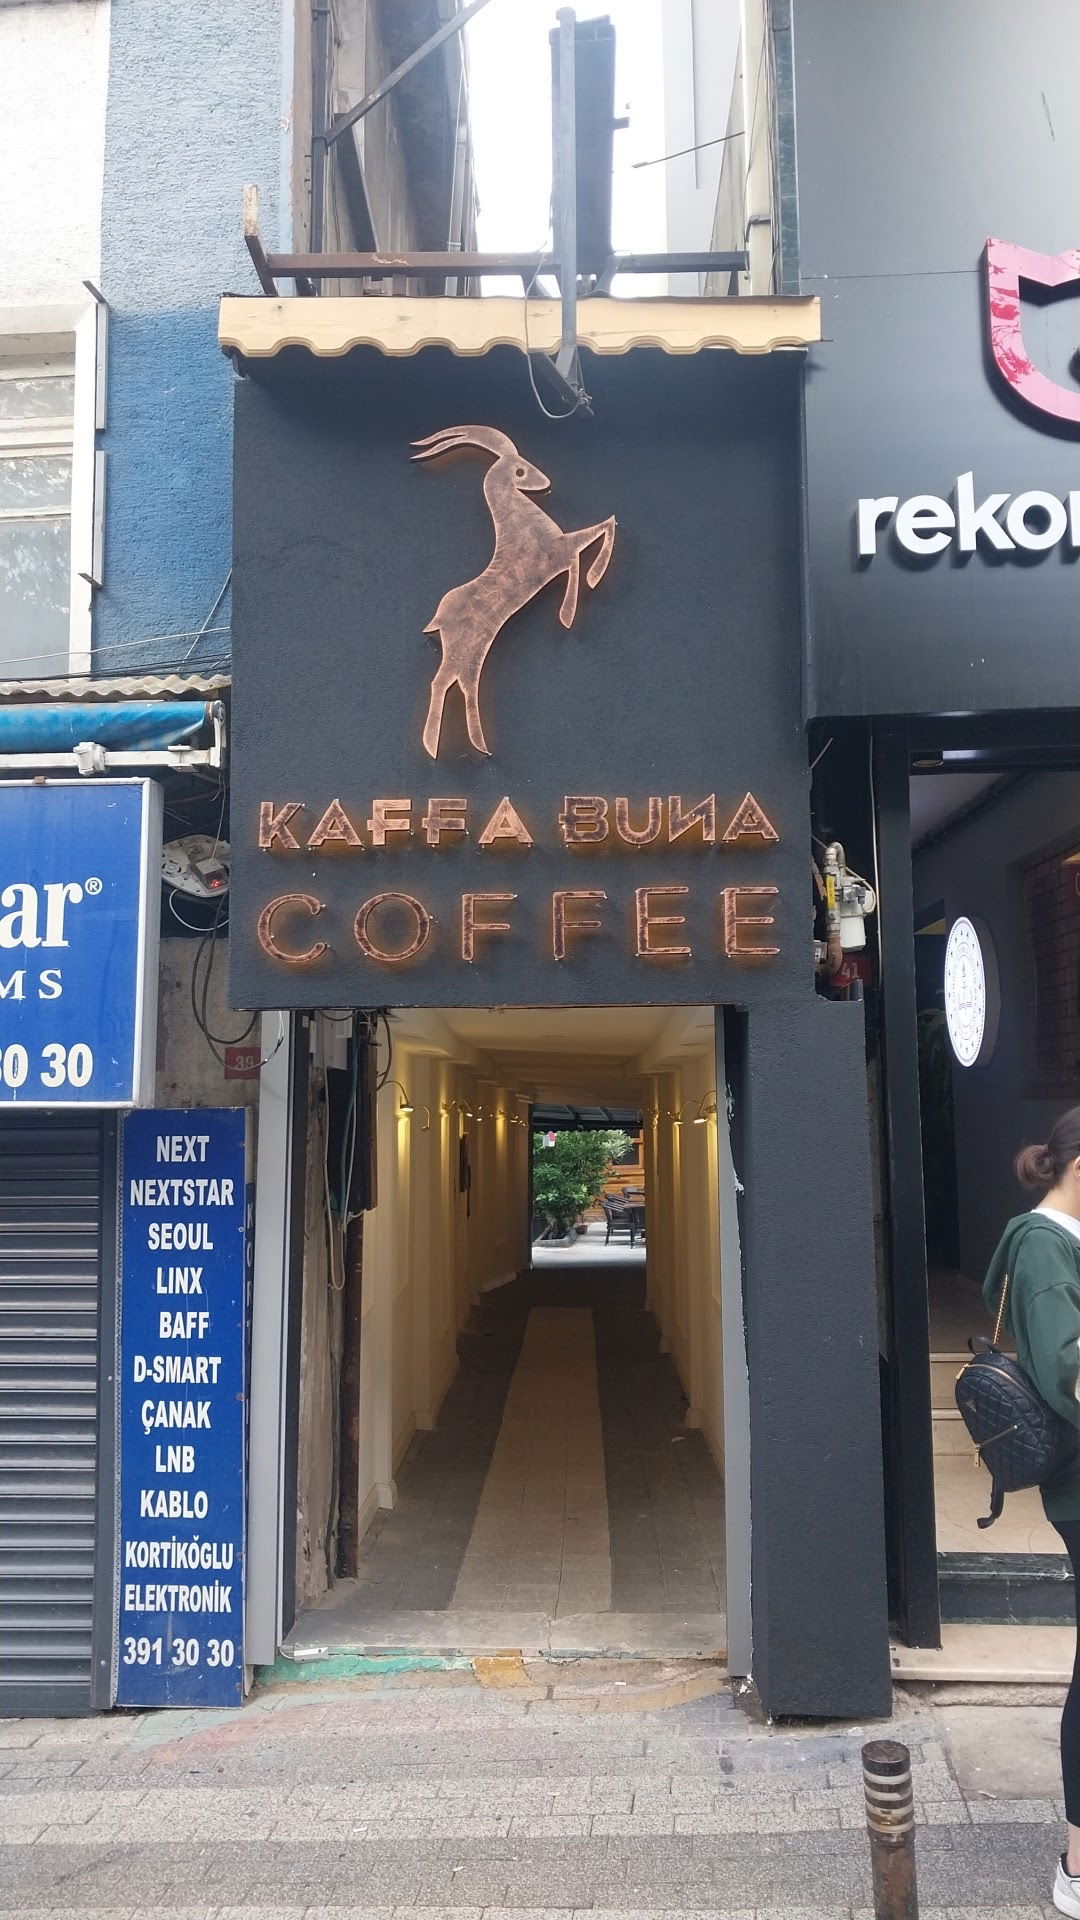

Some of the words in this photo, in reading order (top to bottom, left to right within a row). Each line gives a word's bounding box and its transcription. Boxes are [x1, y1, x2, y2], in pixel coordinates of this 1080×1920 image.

[858, 471, 1080, 555] reko
[258, 797, 532, 850] KAFFA
[257, 887, 780, 964] COFFEE
[841, 962, 860, 979] 41
[0, 1043, 28, 1088] 0
[40, 1043, 93, 1088] 30
[156, 1135, 210, 1162] NEXT
[130, 1179, 234, 1206] NEXTSTAR
[148, 1223, 214, 1250] SEOUL
[156, 1267, 204, 1294] LINX
[159, 1312, 210, 1339] BAFF
[133, 1356, 222, 1384] D-SMART
[141, 1400, 212, 1435] ÇANAK
[155, 1446, 195, 1473] LNB
[140, 1490, 208, 1519] KABLO
[124, 1580, 232, 1613] ELEKTRONİK
[123, 1637, 163, 1666] 391
[172, 1638, 199, 1666] 30
[206, 1639, 234, 1668] 30
